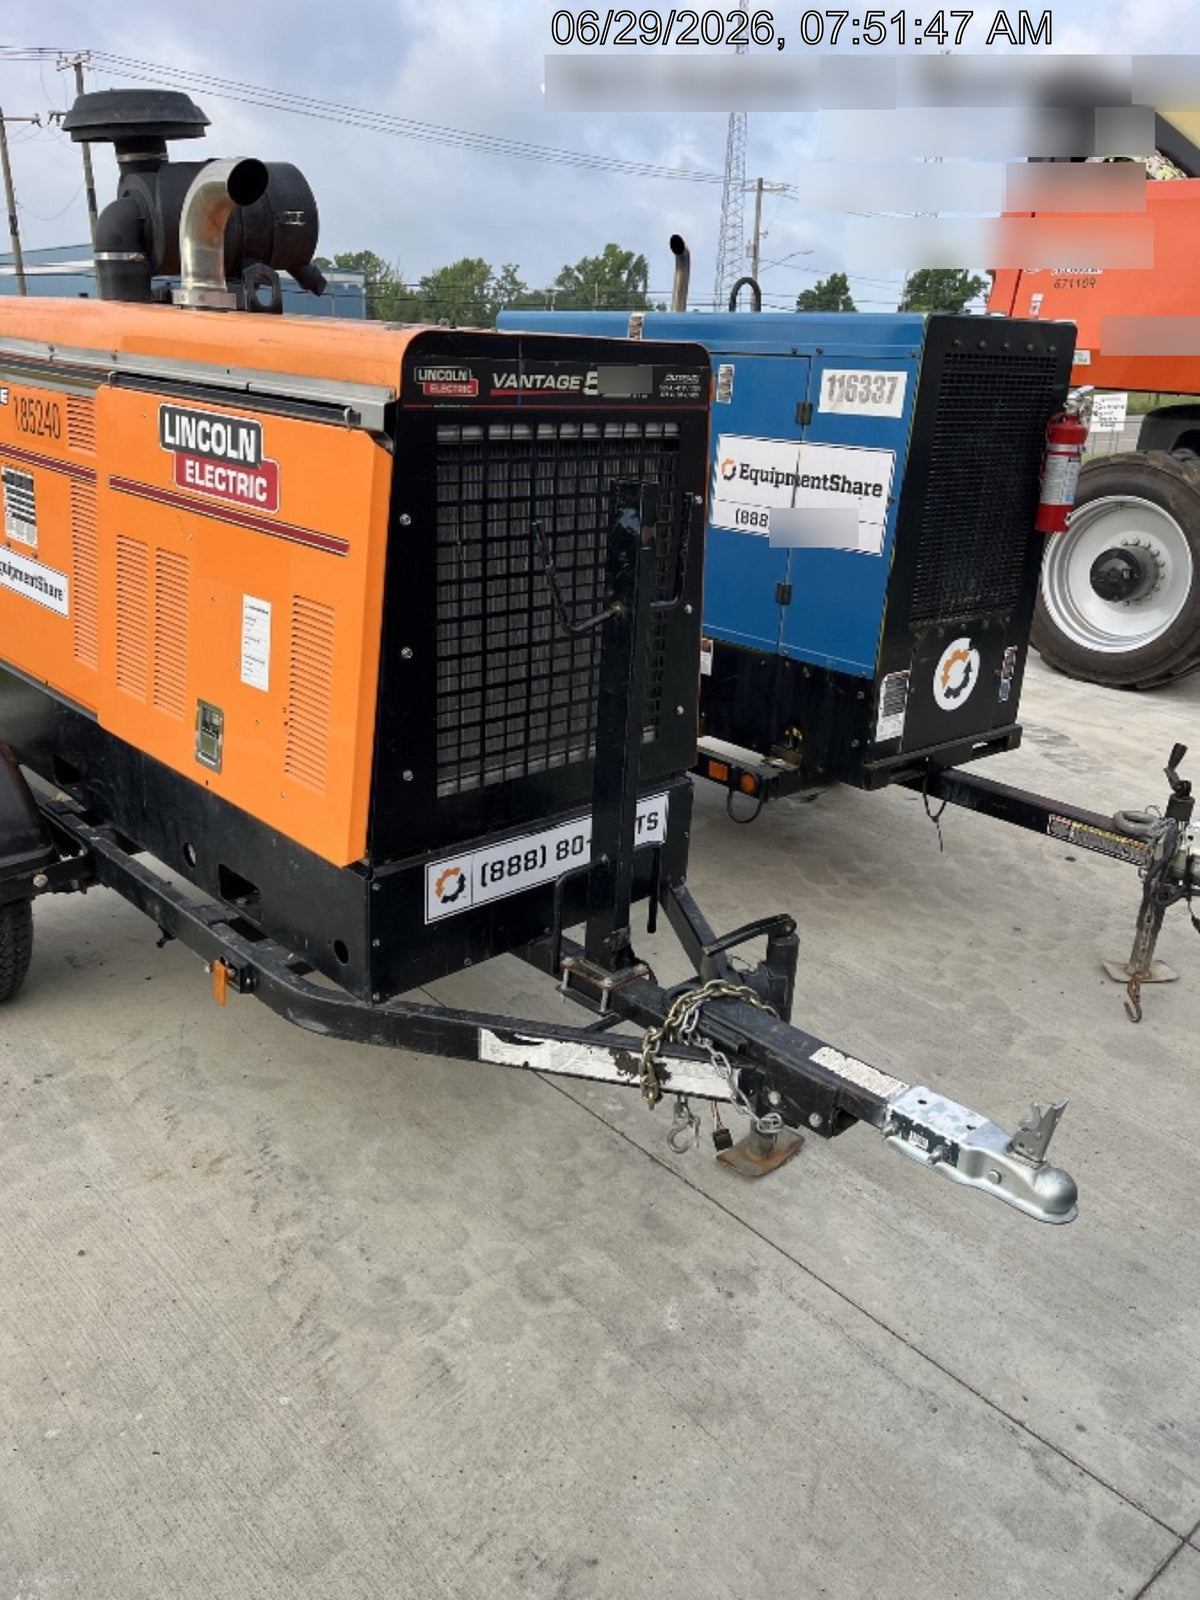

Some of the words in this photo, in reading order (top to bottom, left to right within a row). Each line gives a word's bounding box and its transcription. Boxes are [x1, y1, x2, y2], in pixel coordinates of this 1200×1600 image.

[418, 368, 468, 381] LINCOLN
[429, 383, 473, 394] ELECTRIC
[492, 372, 583, 390] VANTAGE
[826, 374, 899, 404] 116337
[13, 396, 61, 440] 185240
[164, 412, 256, 463] LINCOLN
[185, 459, 268, 502] ELECTRIC
[739, 463, 883, 498] EquipmentShare
[735, 508, 770, 530] (888
[480, 844, 547, 887] (888)
